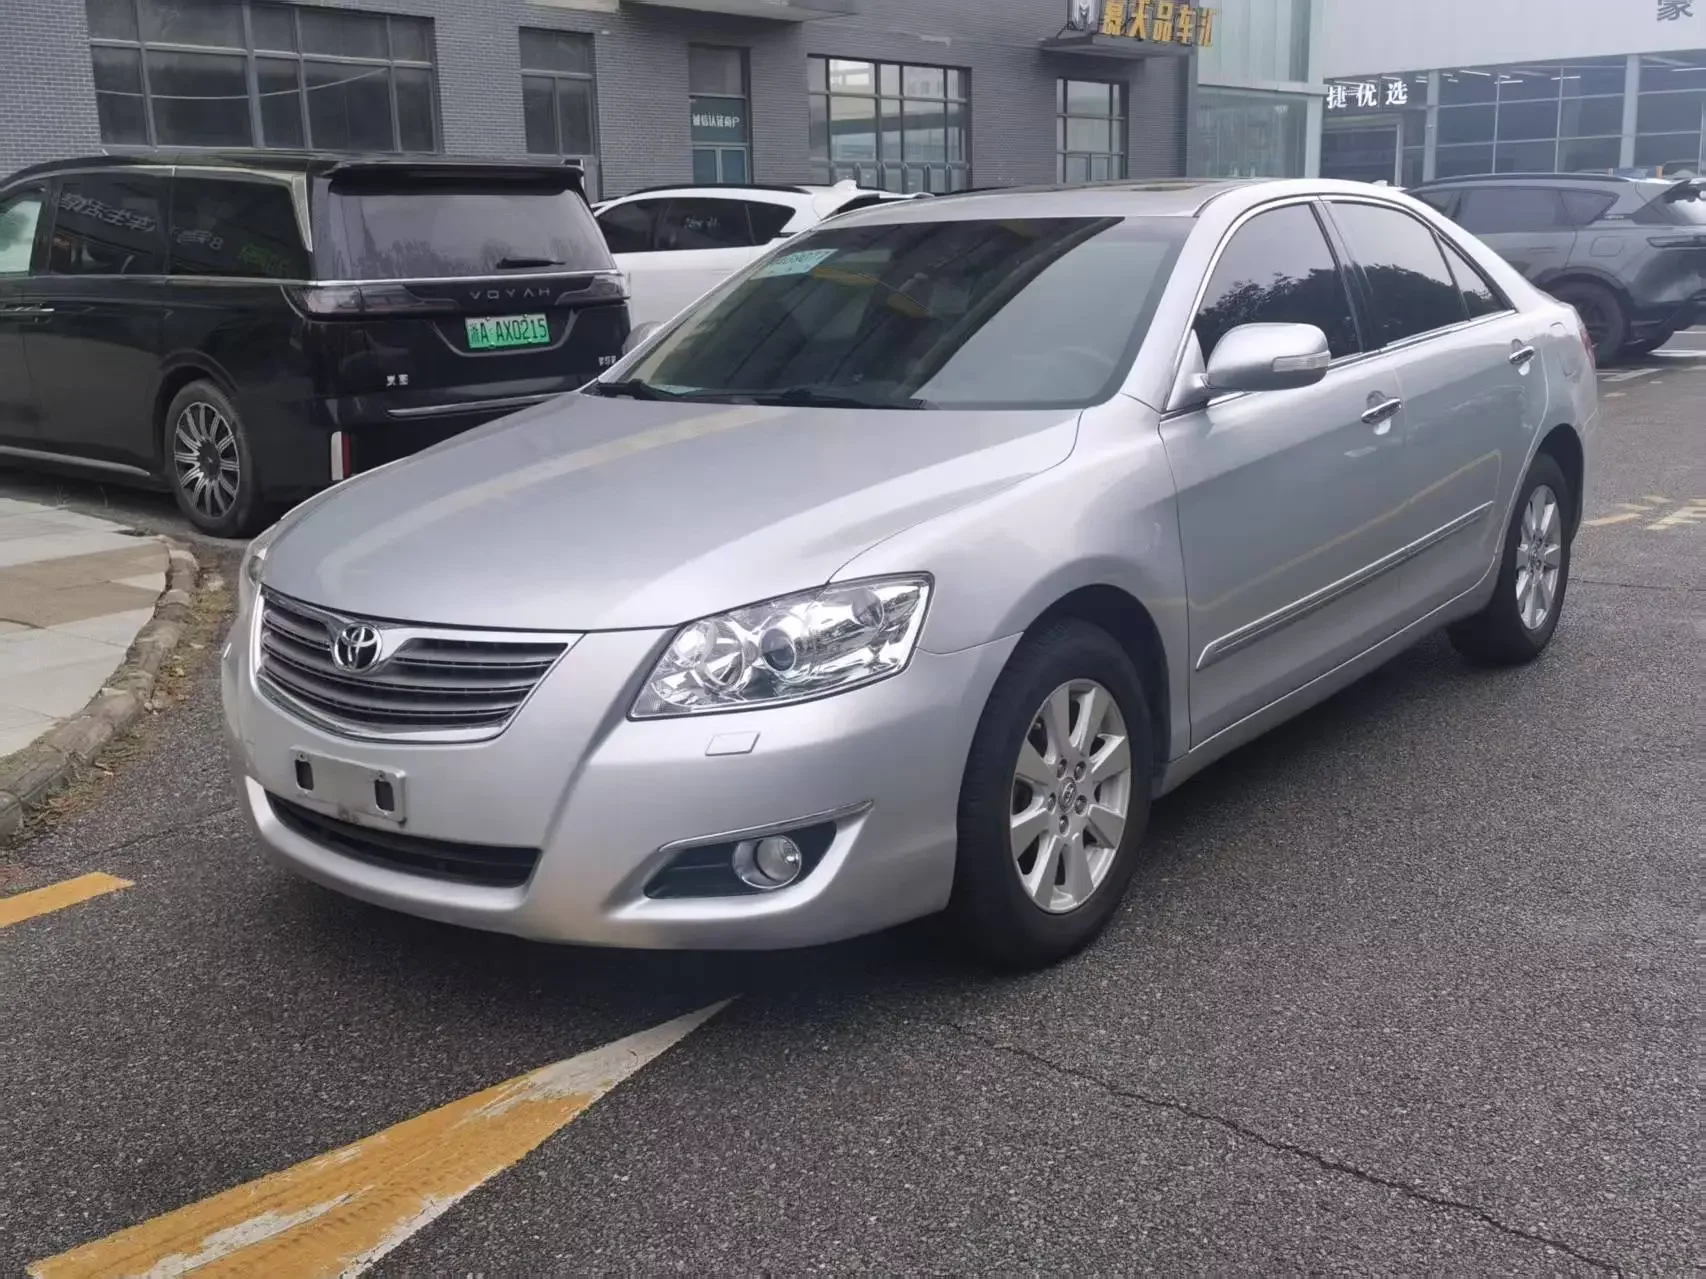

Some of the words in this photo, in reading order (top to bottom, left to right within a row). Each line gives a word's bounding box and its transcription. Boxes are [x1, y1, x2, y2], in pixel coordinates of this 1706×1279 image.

[1326, 81, 1408, 109] 捷优选
[469, 288, 550, 300] VOYAH
